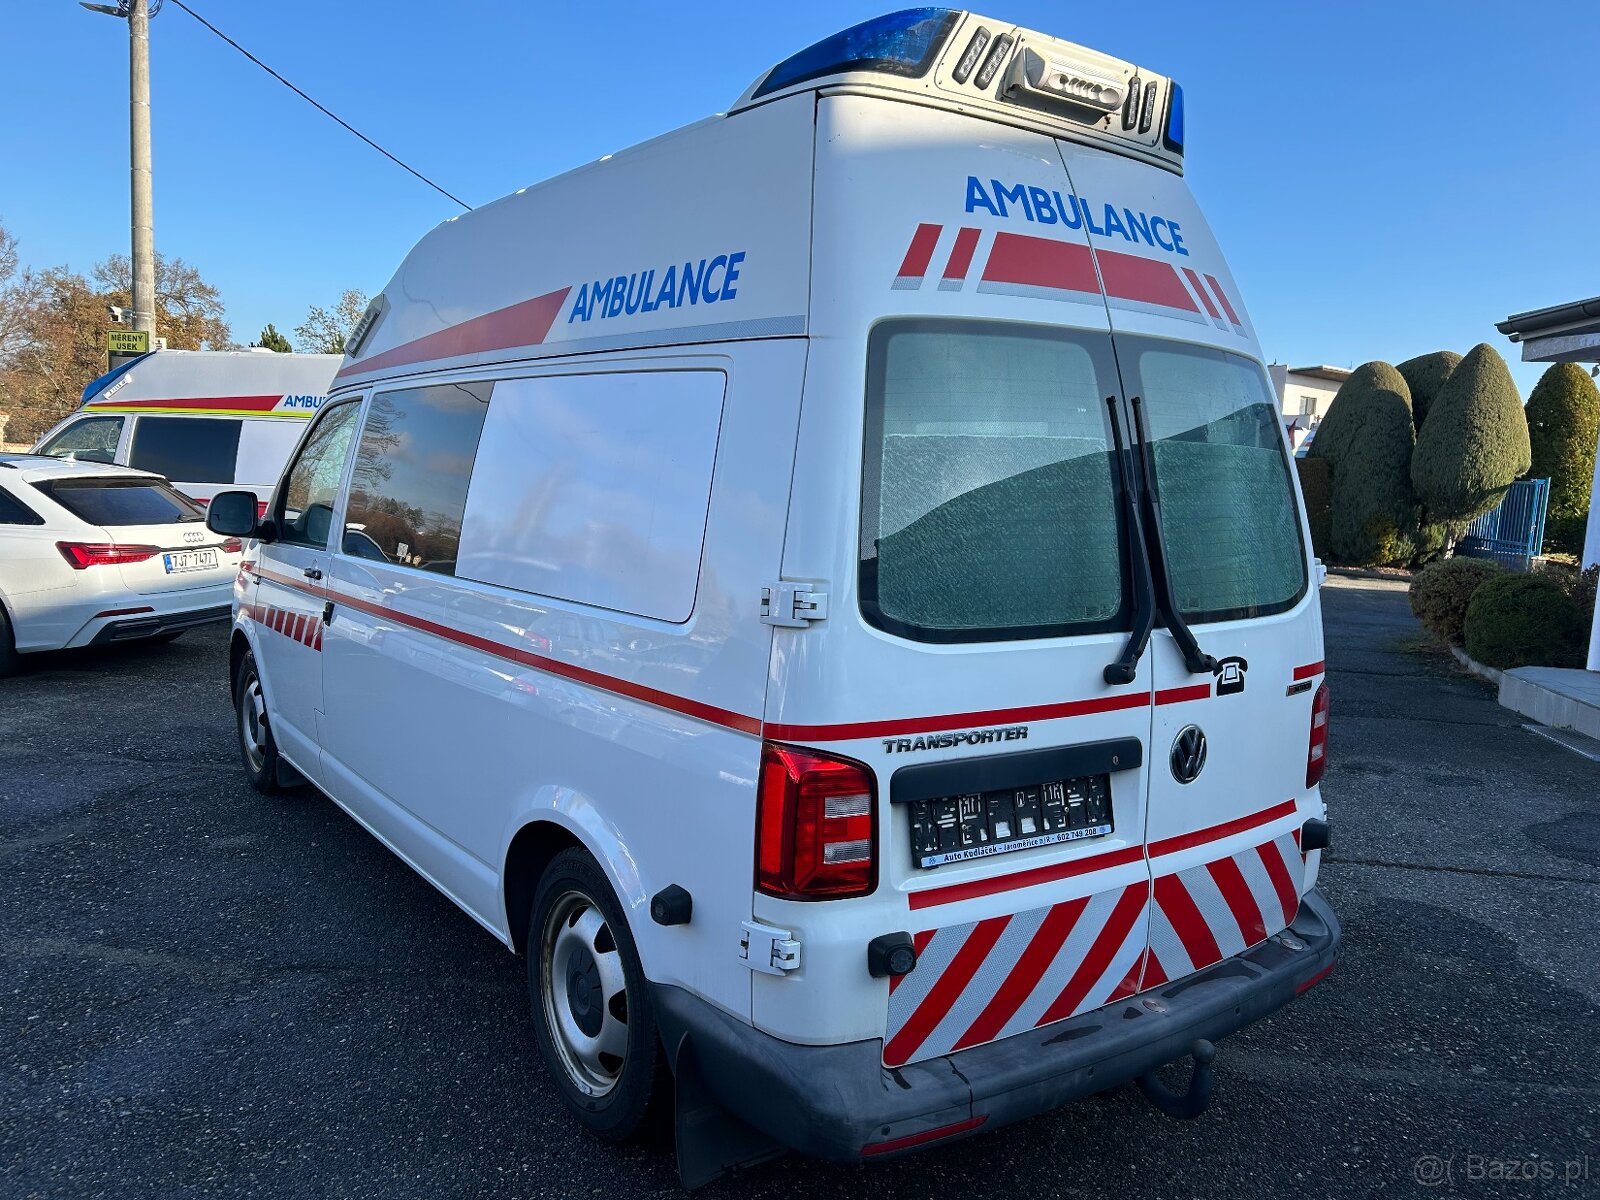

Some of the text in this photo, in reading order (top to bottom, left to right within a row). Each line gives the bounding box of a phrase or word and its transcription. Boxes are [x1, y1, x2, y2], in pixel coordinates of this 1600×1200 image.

[965, 175, 1190, 257] AMBULANCE
[568, 251, 746, 324] AMBULANCE
[284, 395, 326, 408] AMBU
[883, 726, 1029, 754] TRANSPORTER
[944, 852, 962, 862] Auto
[963, 845, 998, 859] Kudláček
[1057, 832, 1070, 841] 602
[1071, 830, 1083, 839] 749
[1084, 828, 1097, 836] 208
